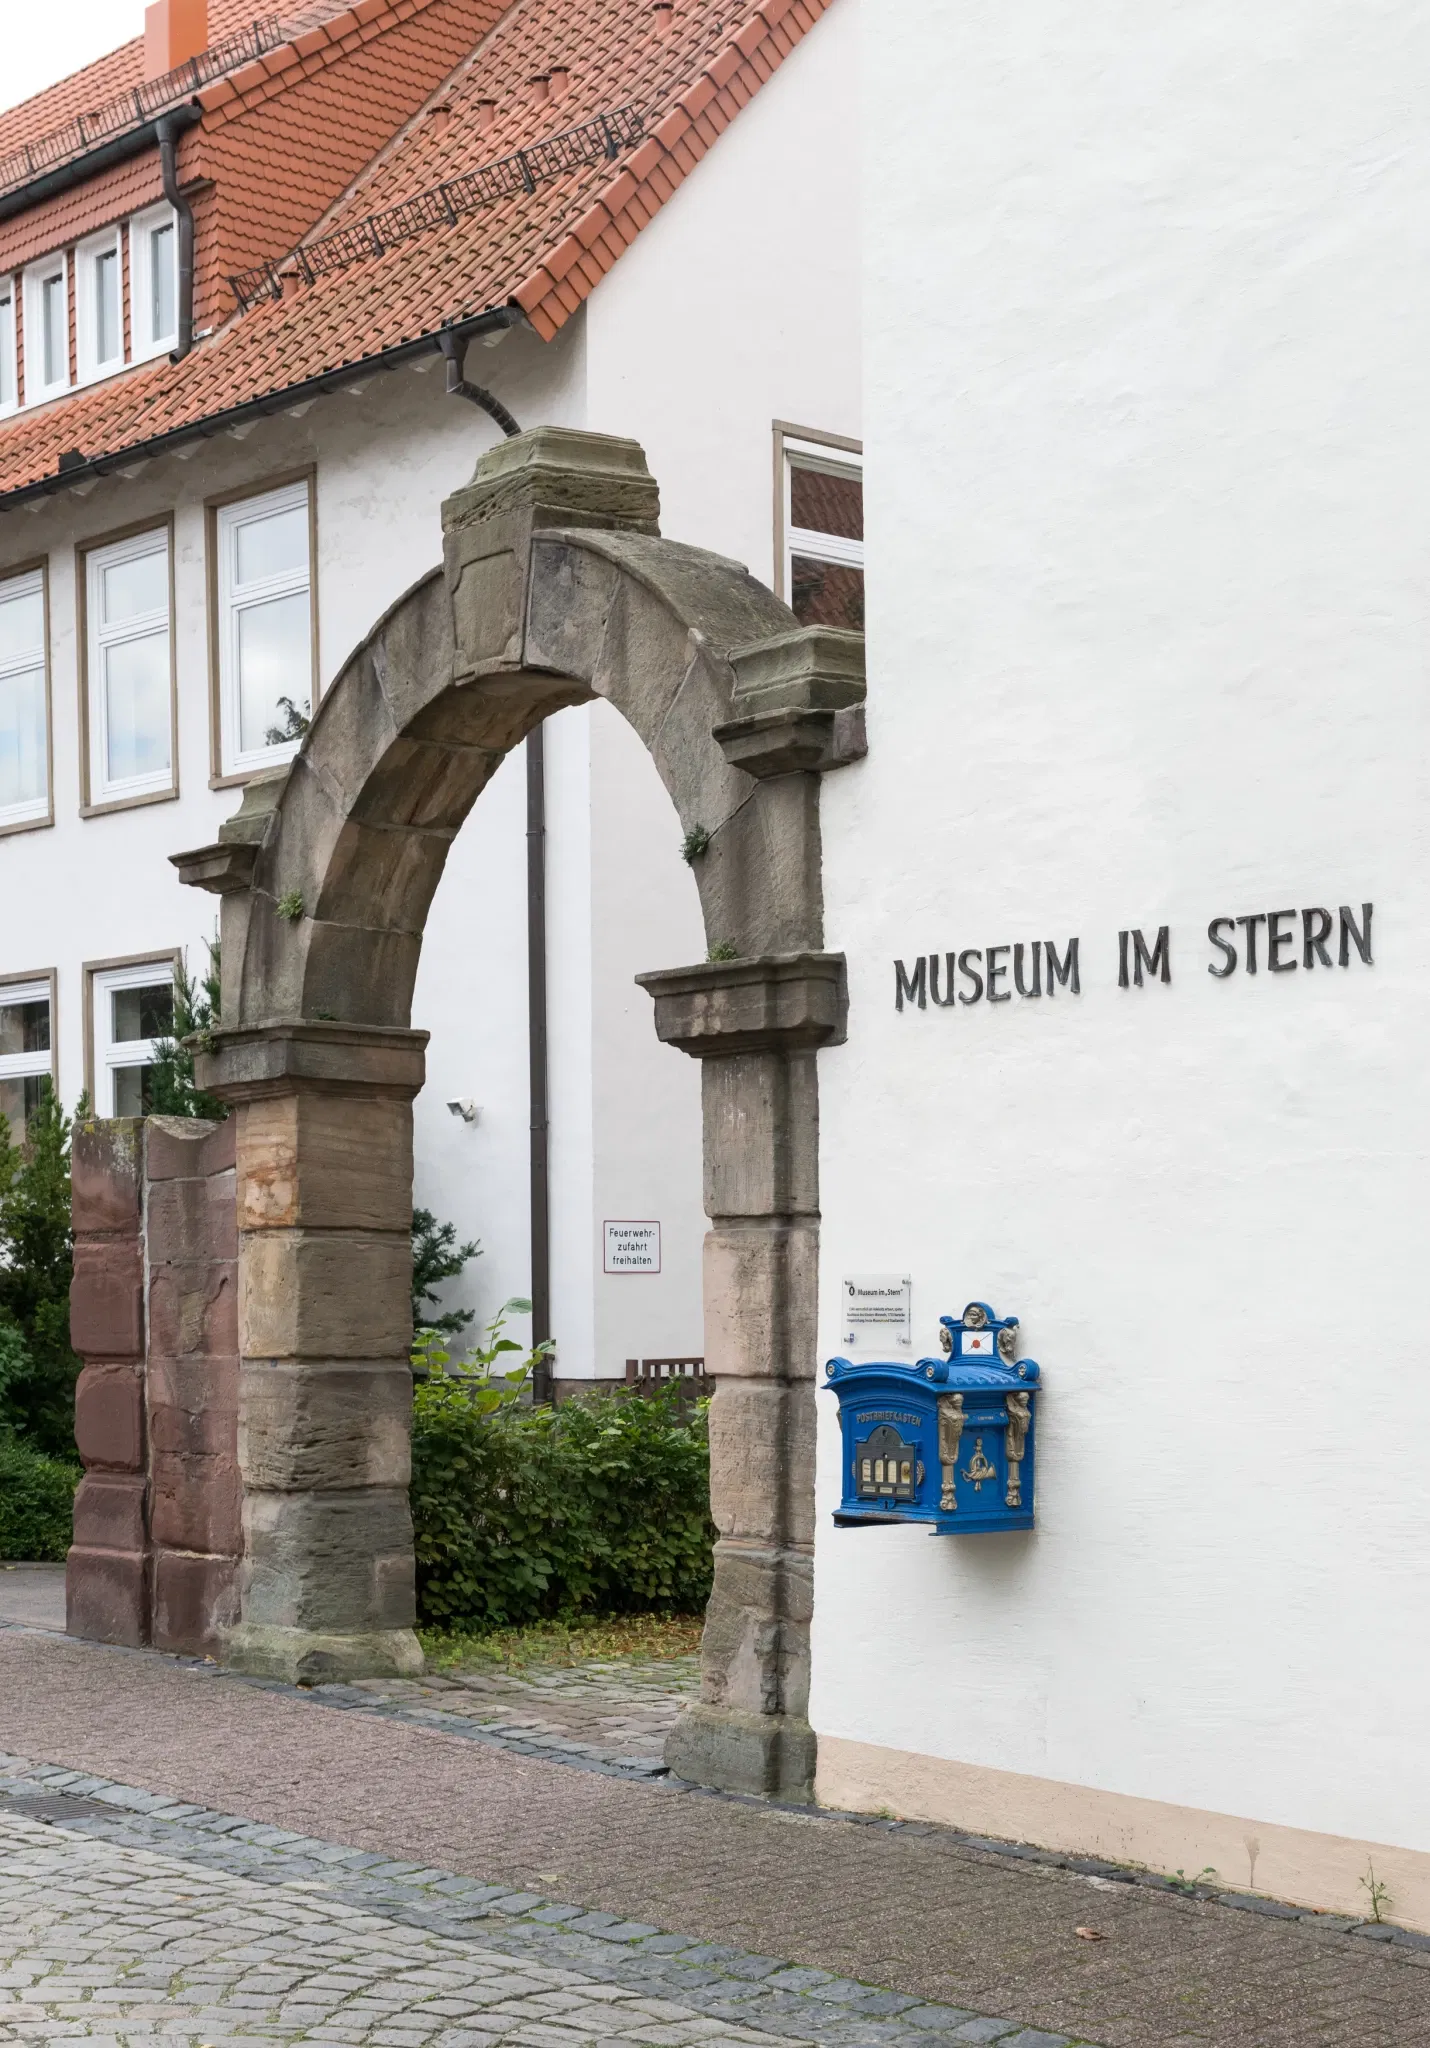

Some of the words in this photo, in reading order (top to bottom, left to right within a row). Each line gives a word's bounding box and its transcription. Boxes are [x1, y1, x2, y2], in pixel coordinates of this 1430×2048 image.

[893, 937, 1080, 1011] MUSEUM
[1117, 925, 1171, 987] IM
[1207, 902, 1373, 978] STERN
[609, 1228, 655, 1237] Feuerwehr-
[617, 1242, 648, 1251] zufahrt
[612, 1256, 652, 1265] freihalten
[856, 1410, 921, 1427] POSTBRIEFKASTEN
